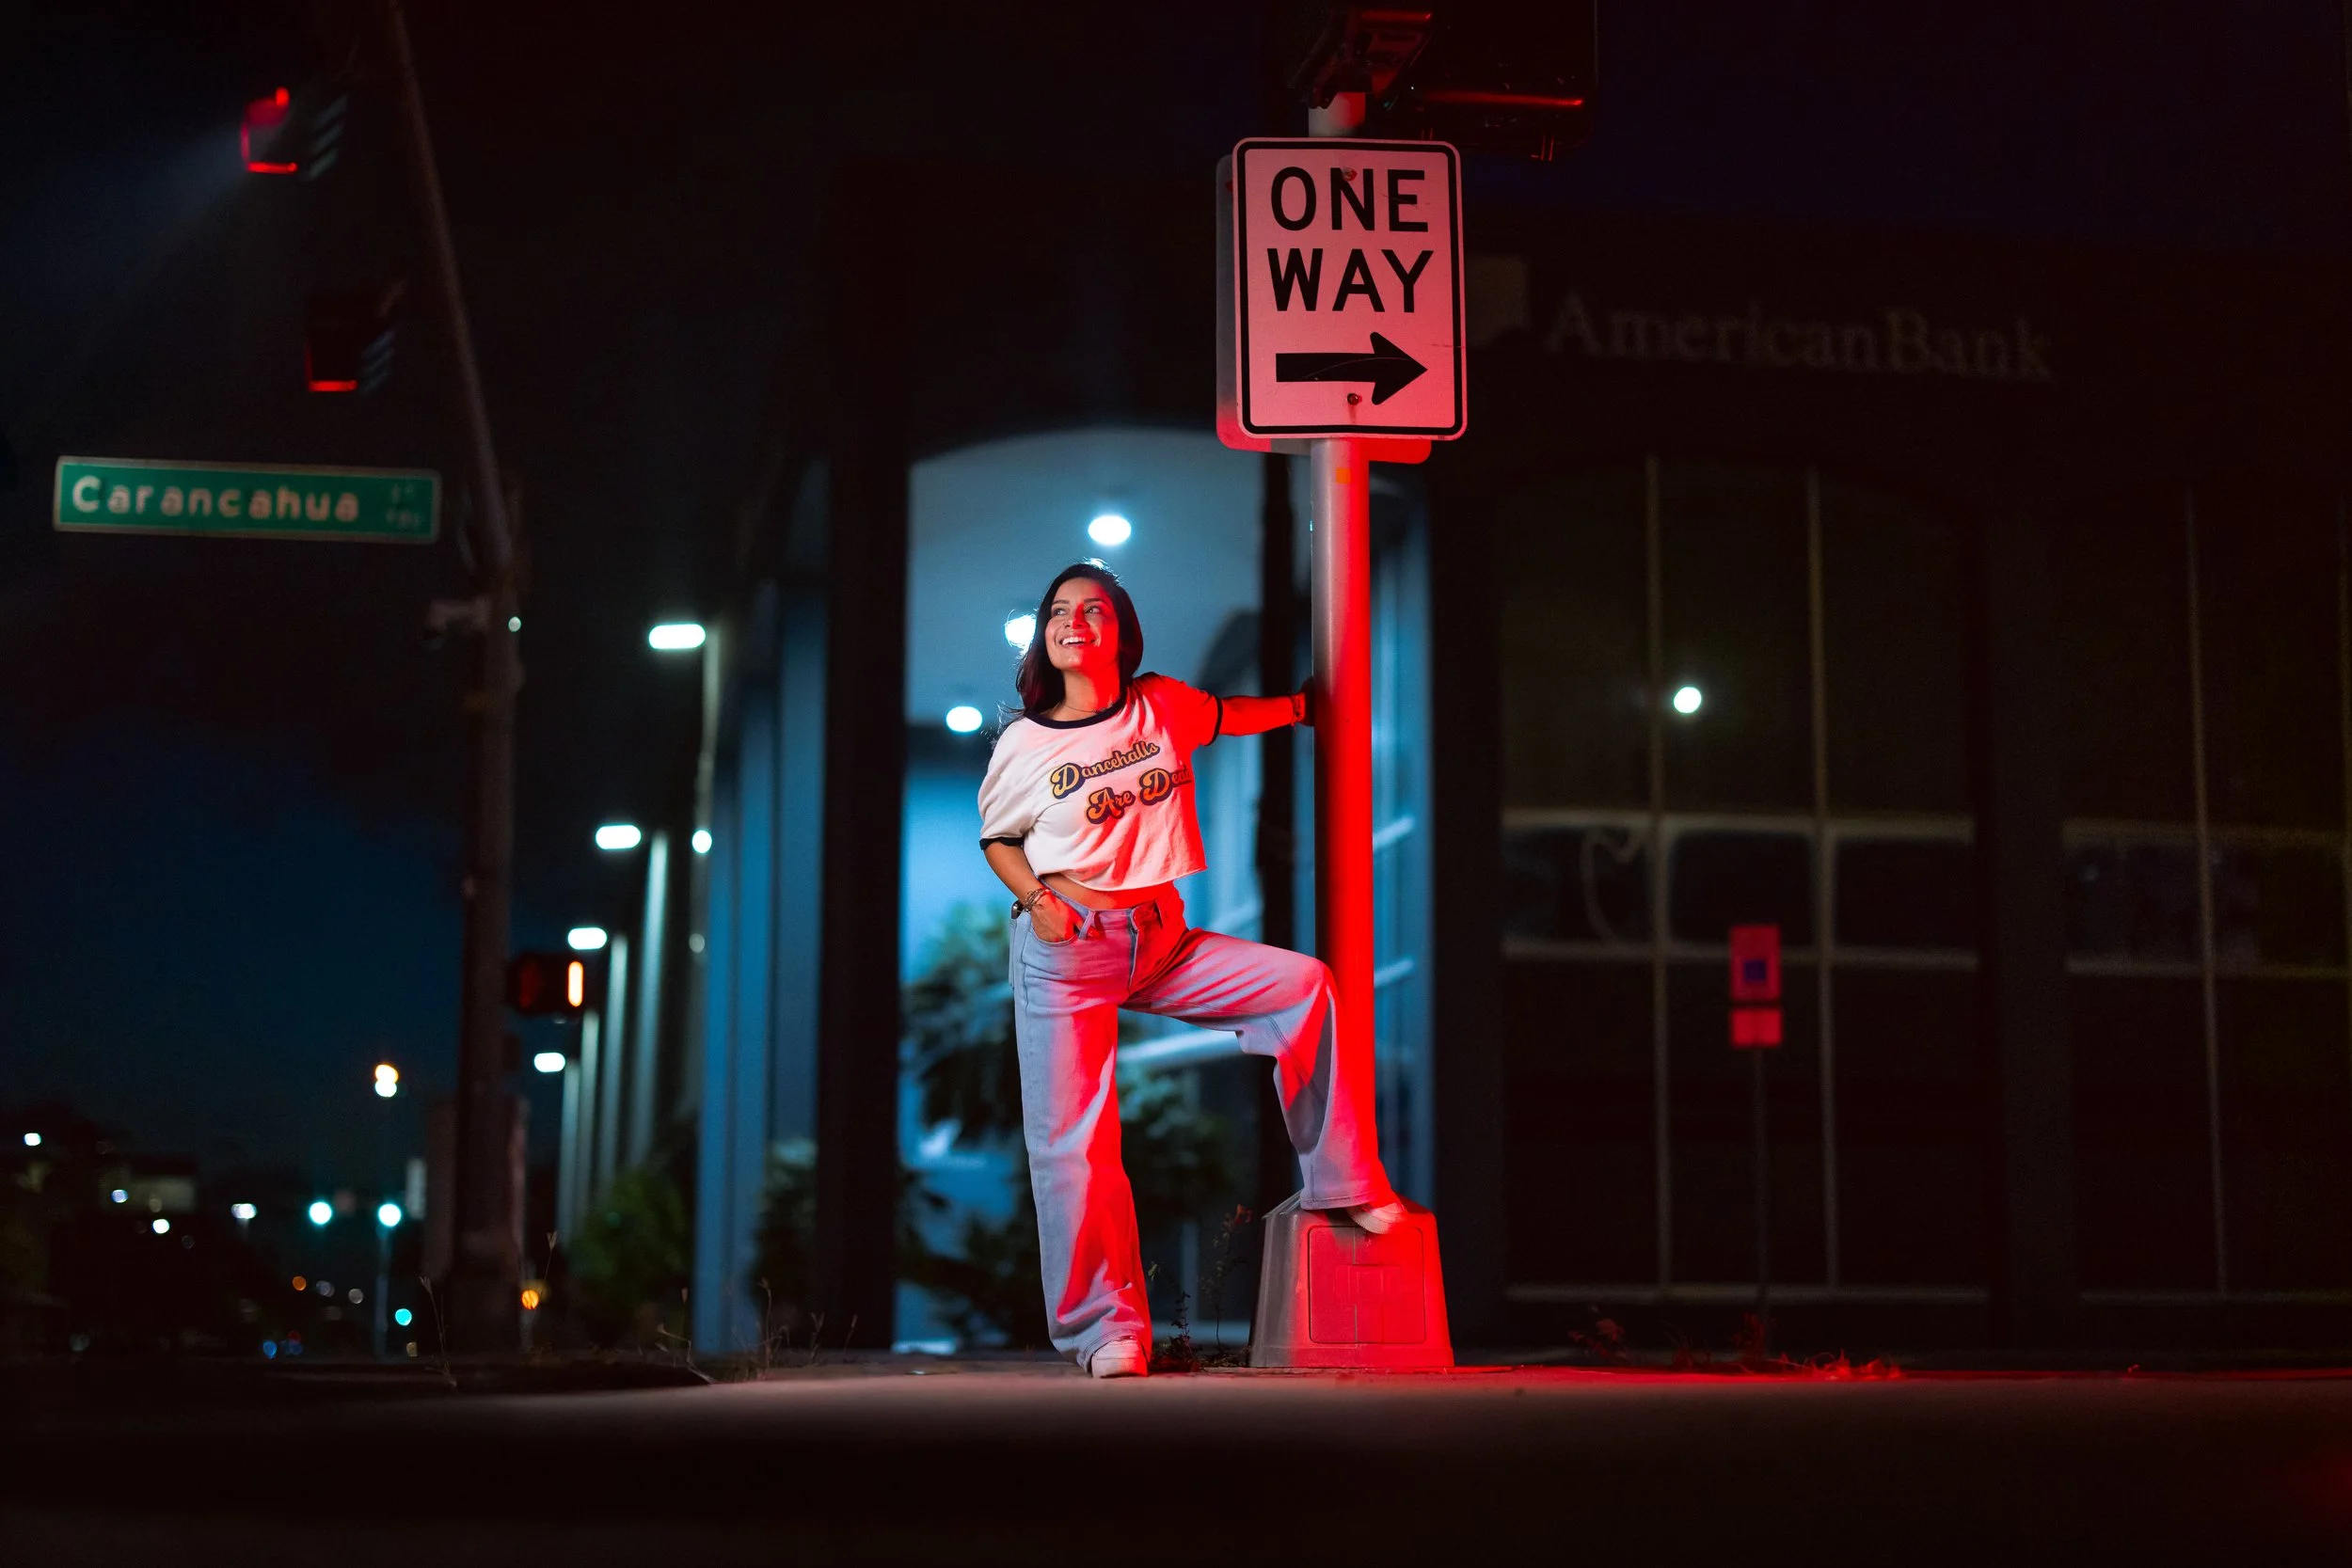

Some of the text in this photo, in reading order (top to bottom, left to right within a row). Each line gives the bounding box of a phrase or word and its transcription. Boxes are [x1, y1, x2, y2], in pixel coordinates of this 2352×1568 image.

[1270, 166, 1429, 232] ONE
[1266, 247, 1435, 313] WAY
[72, 474, 360, 522] Carancahua
[1050, 740, 1160, 800] Dancehalls
[1086, 786, 1136, 824] Are
